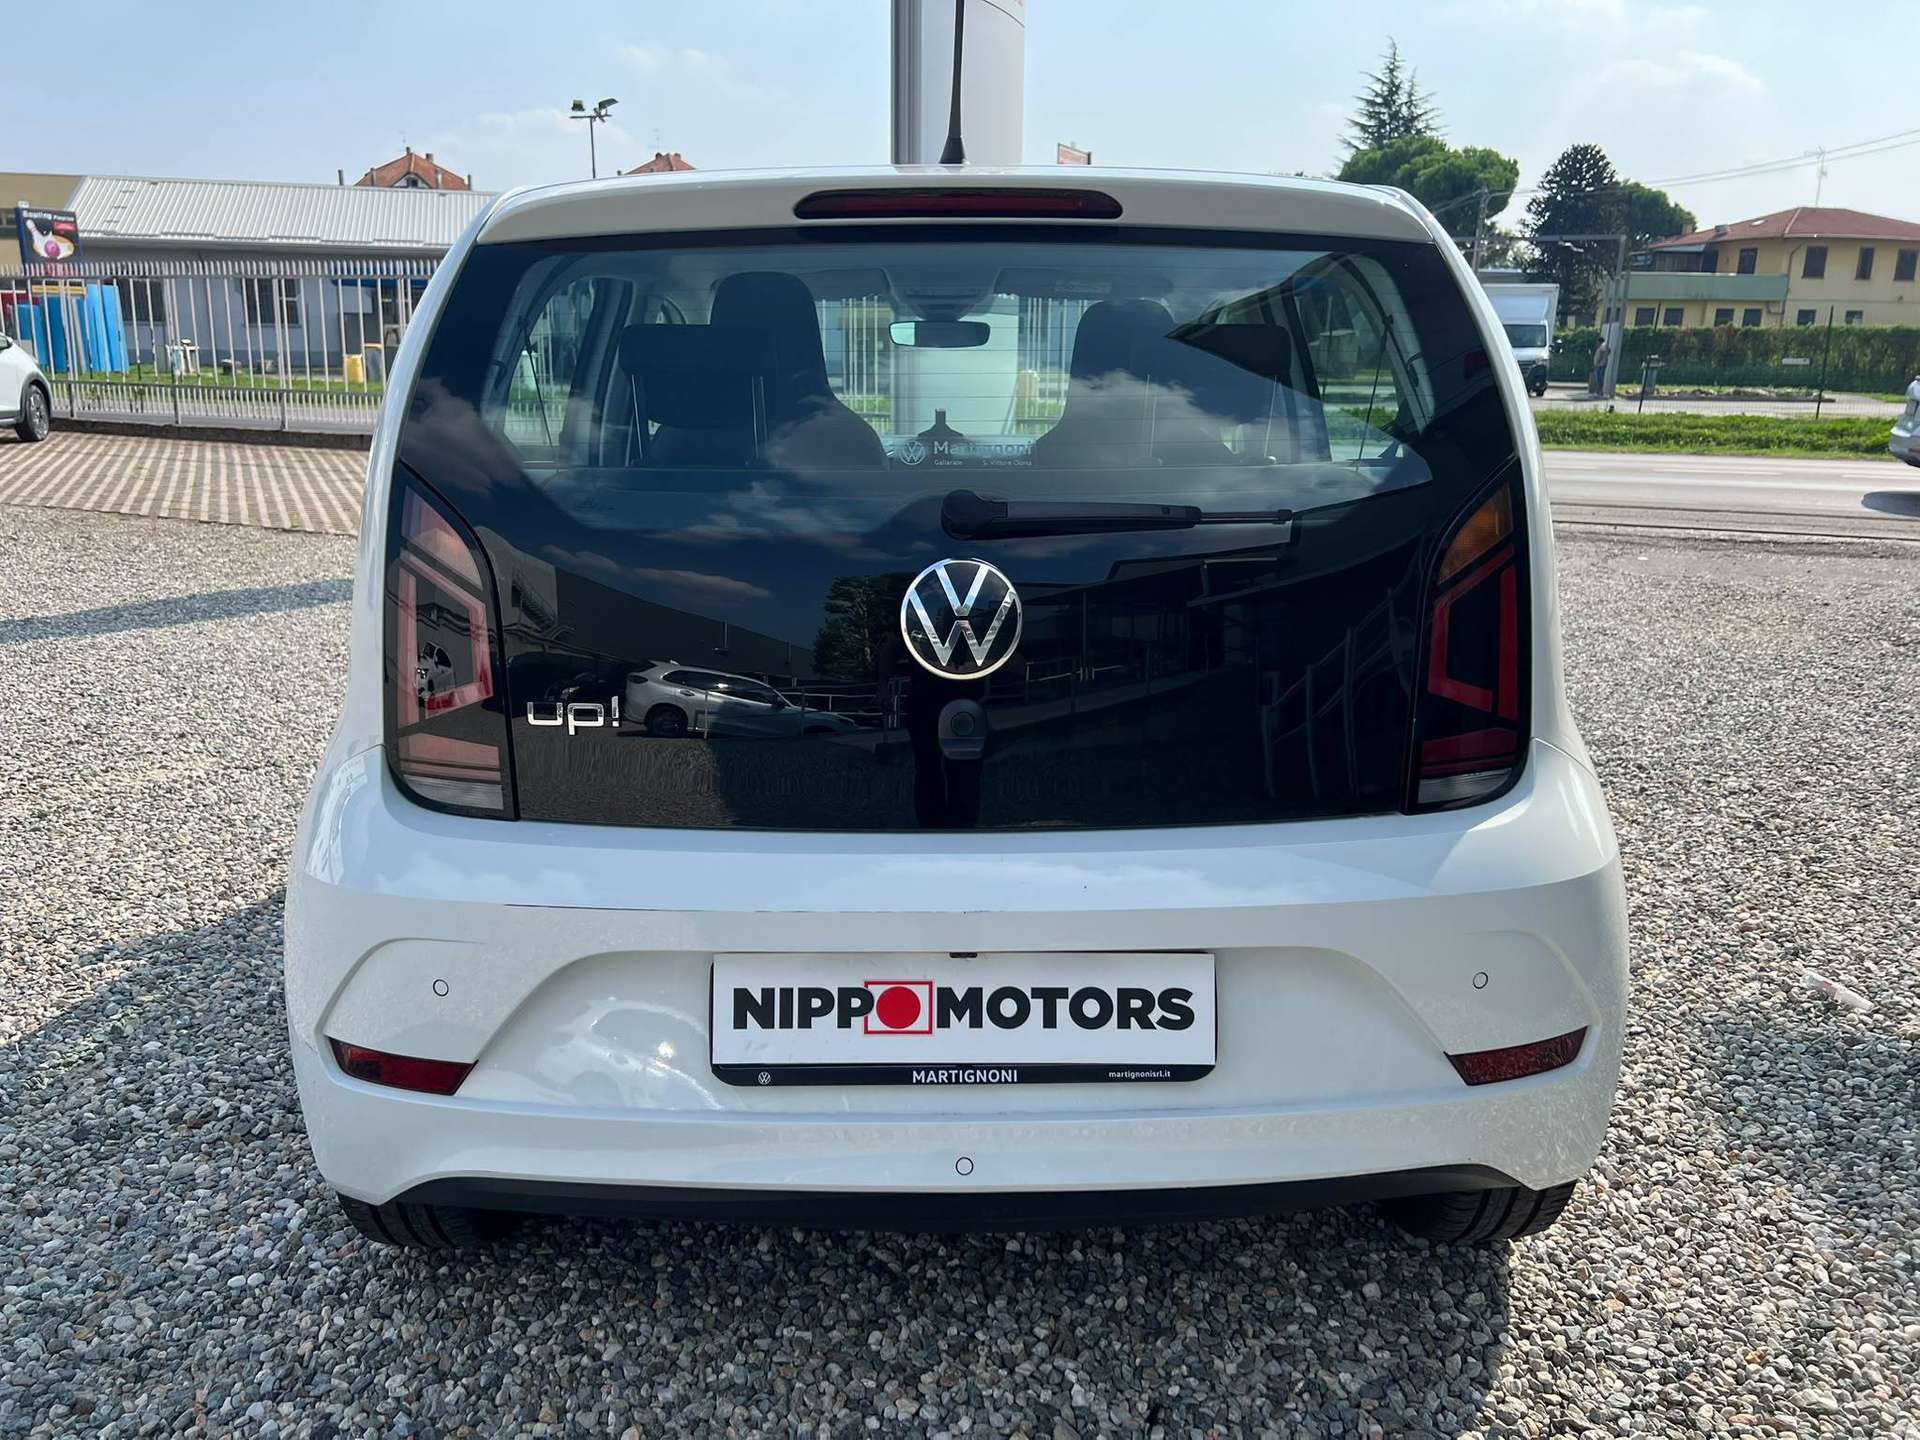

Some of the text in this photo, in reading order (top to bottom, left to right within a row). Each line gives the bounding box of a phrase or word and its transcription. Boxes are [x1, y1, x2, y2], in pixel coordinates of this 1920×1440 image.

[527, 695, 620, 735] up!
[911, 1069, 1018, 1084] MARTIGNONI
[1108, 1069, 1171, 1080] martignonisrl.it
